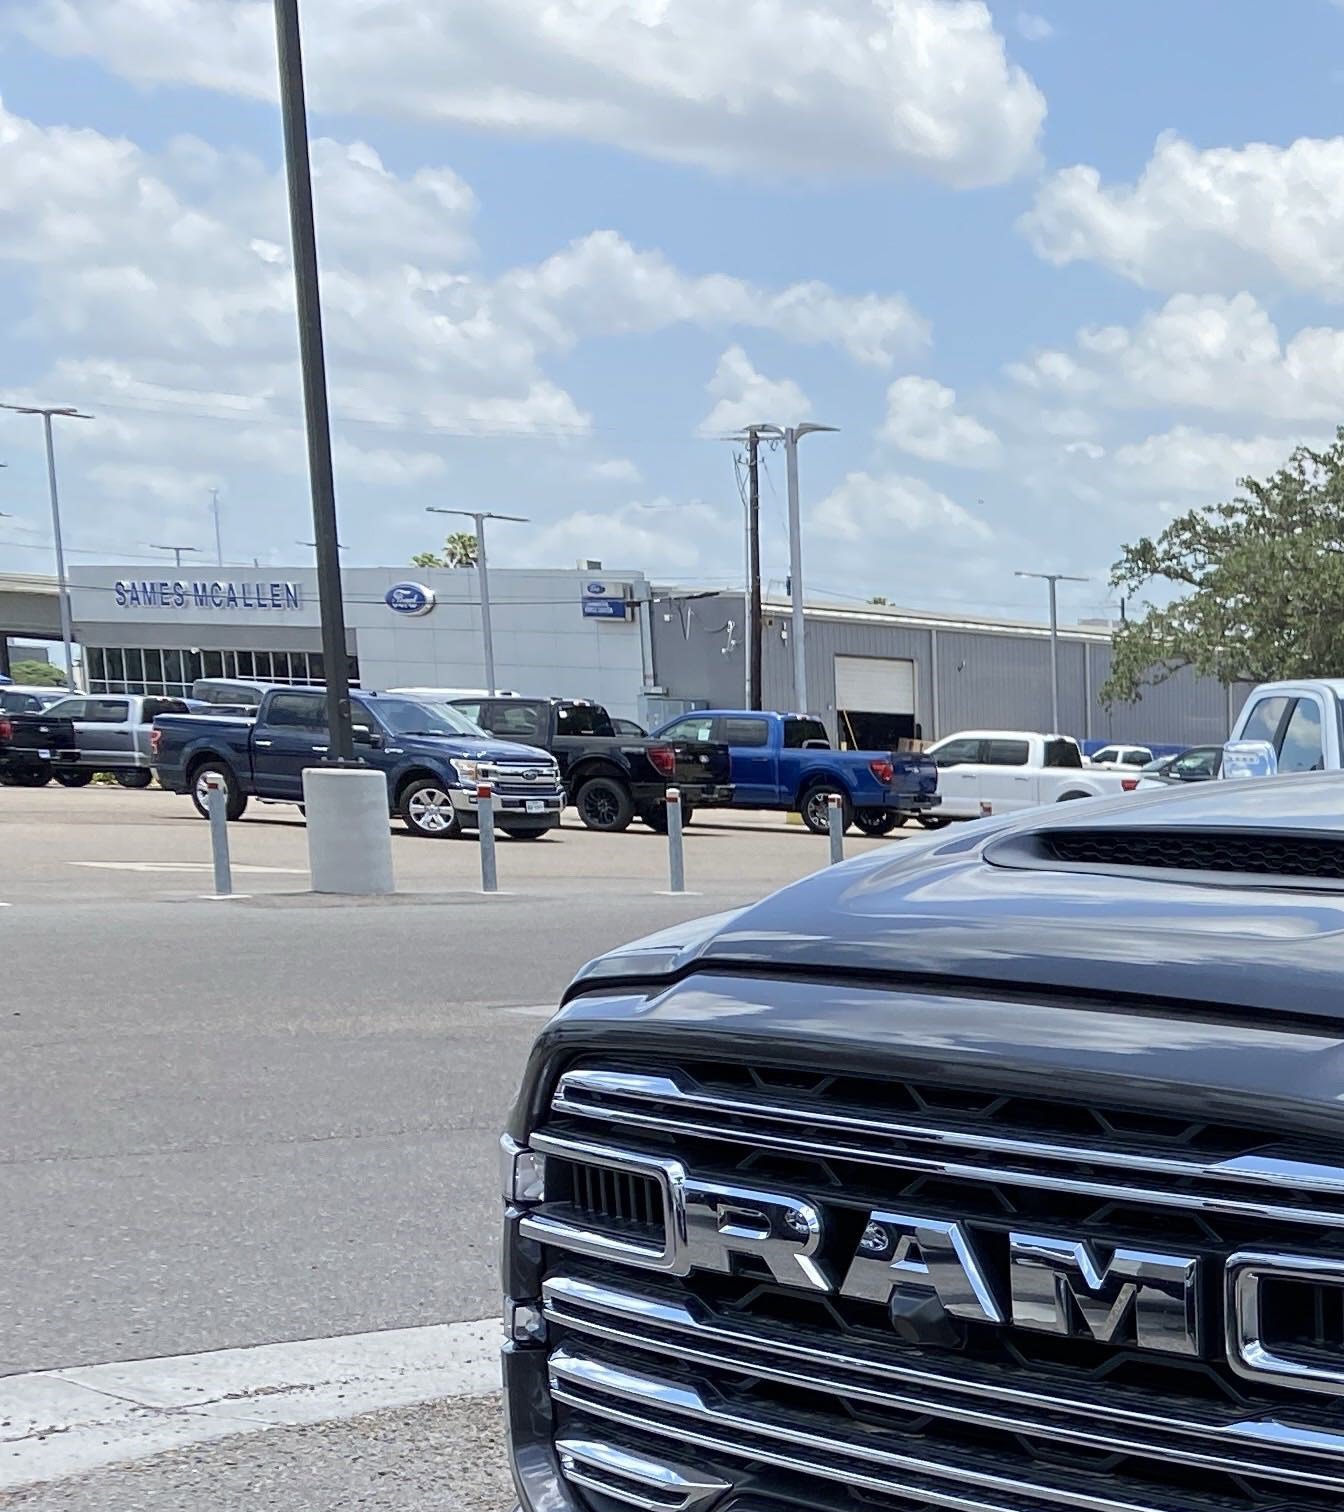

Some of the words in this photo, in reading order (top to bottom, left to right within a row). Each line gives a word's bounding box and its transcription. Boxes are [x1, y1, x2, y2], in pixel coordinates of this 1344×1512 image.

[115, 581, 184, 606] SAMES
[192, 582, 299, 608] MCALLEN
[683, 1178, 1200, 1356] RAM
